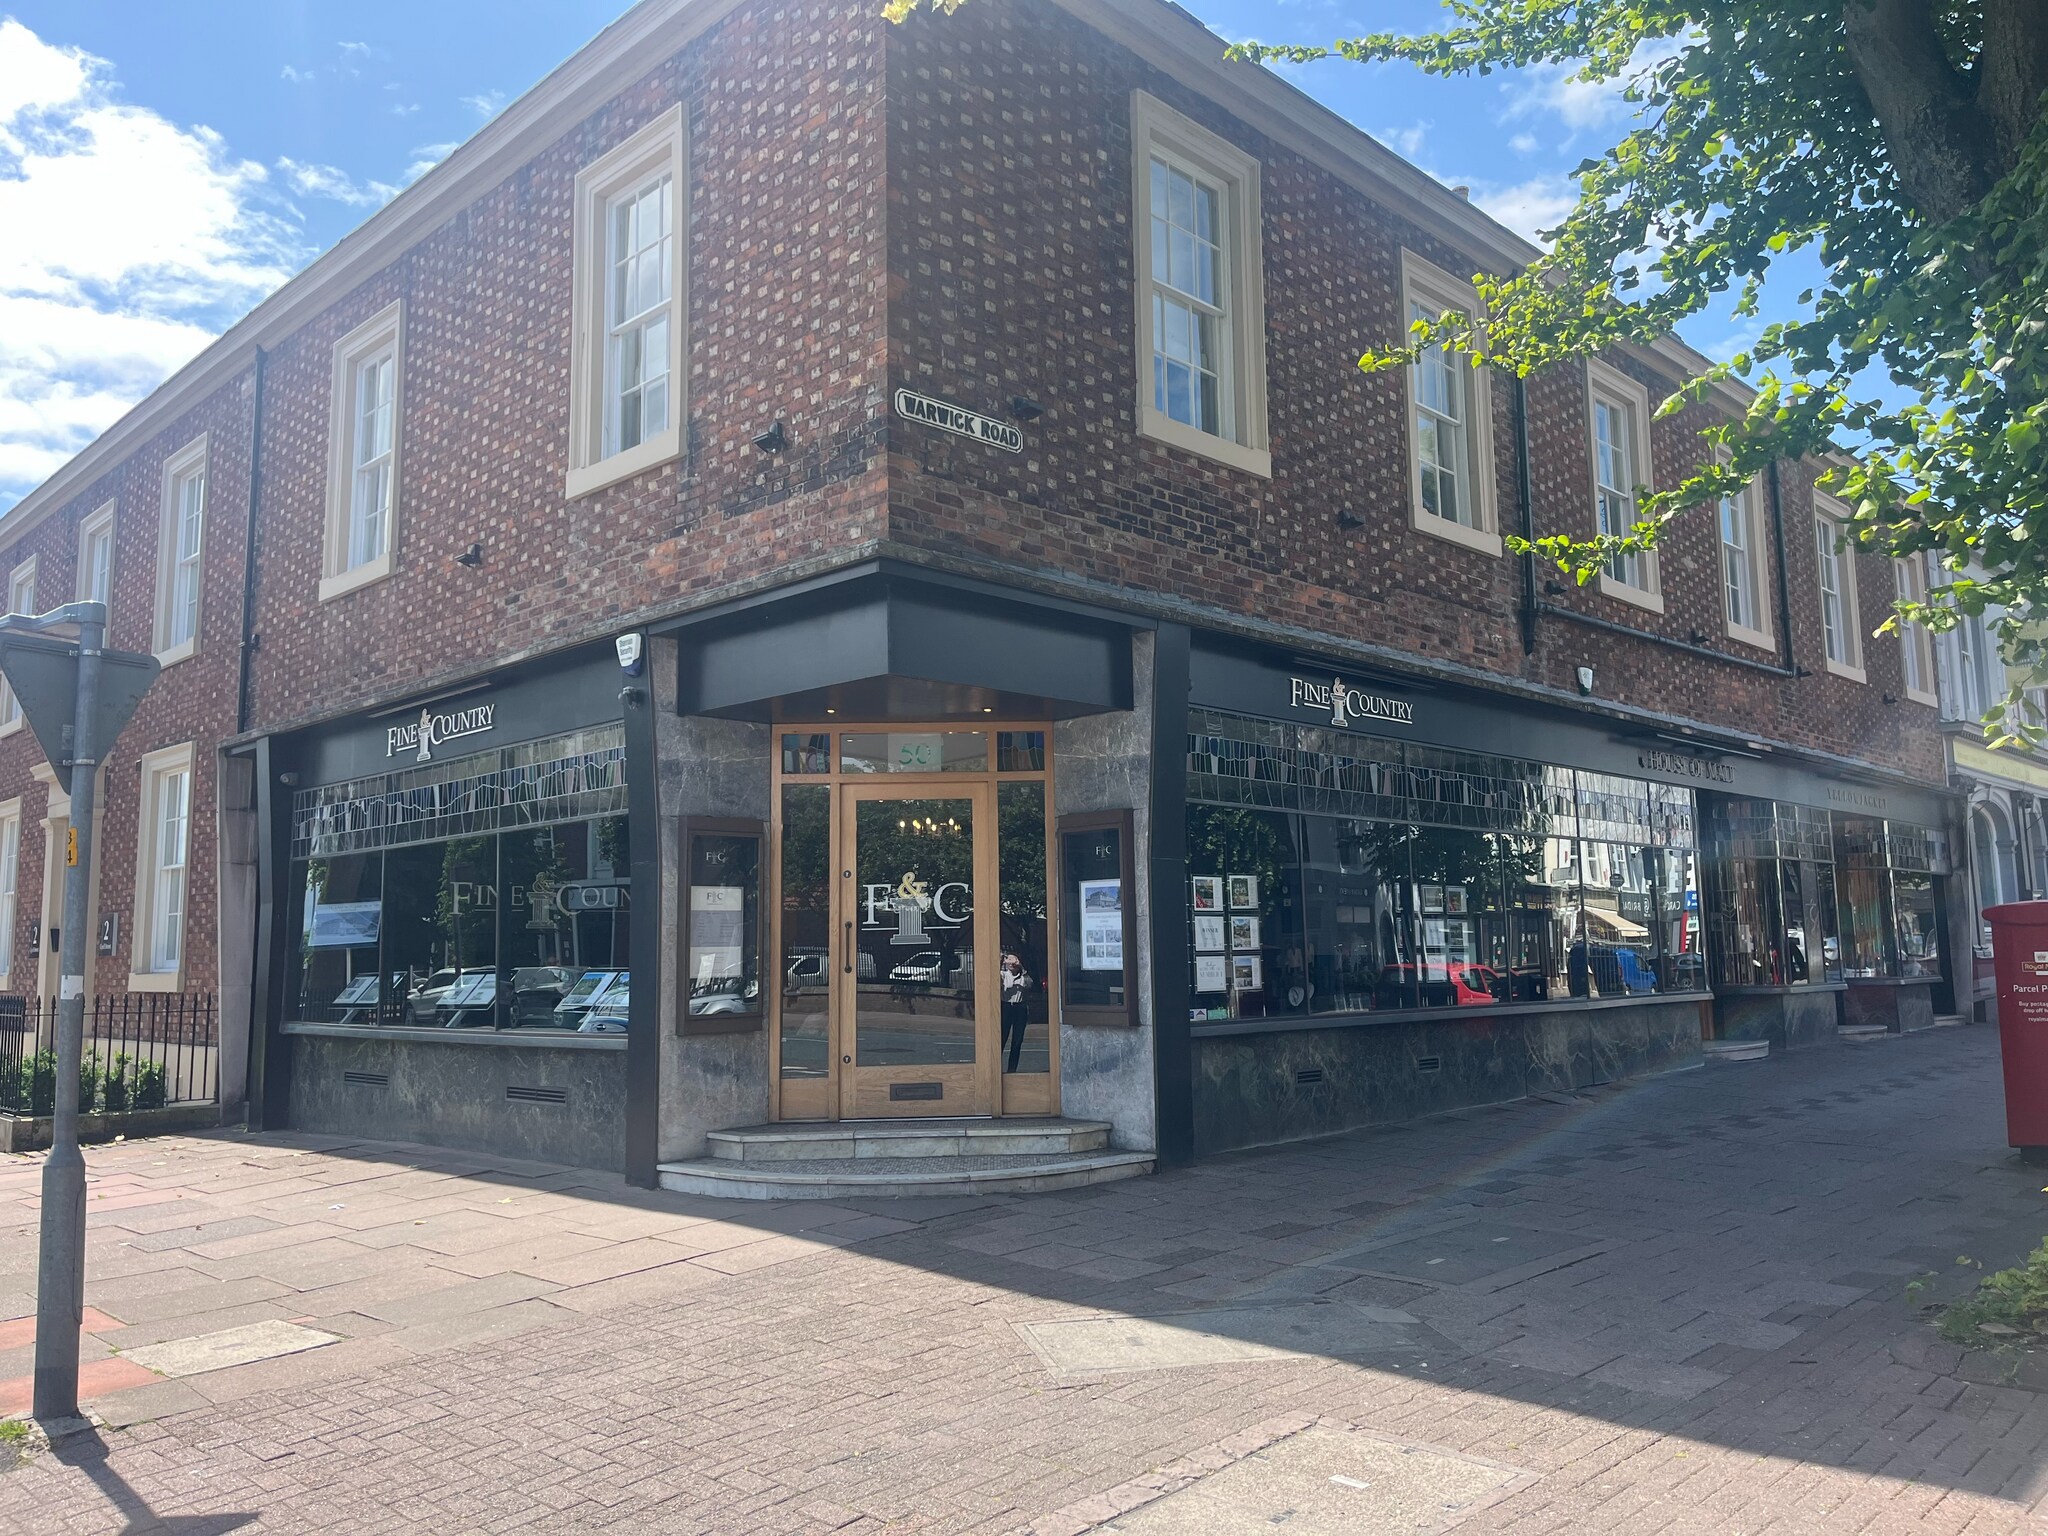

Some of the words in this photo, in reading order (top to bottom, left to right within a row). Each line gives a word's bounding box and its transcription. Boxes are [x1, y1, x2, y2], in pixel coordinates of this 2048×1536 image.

[904, 395, 976, 434] WARWICK
[981, 420, 1018, 448] ROAD
[1290, 677, 1331, 707] FINE
[1346, 689, 1414, 720] COUNTRY
[386, 723, 418, 757] FINE
[430, 703, 495, 745] COUNTRY
[898, 743, 932, 765] 50
[450, 881, 524, 915] FINE
[862, 884, 892, 925] F
[898, 871, 928, 898] &
[933, 882, 970, 923] C
[32, 926, 39, 945] 2
[102, 920, 110, 941] 2
[2024, 963, 2044, 971] Royal
[2013, 984, 2039, 993] Parcel
